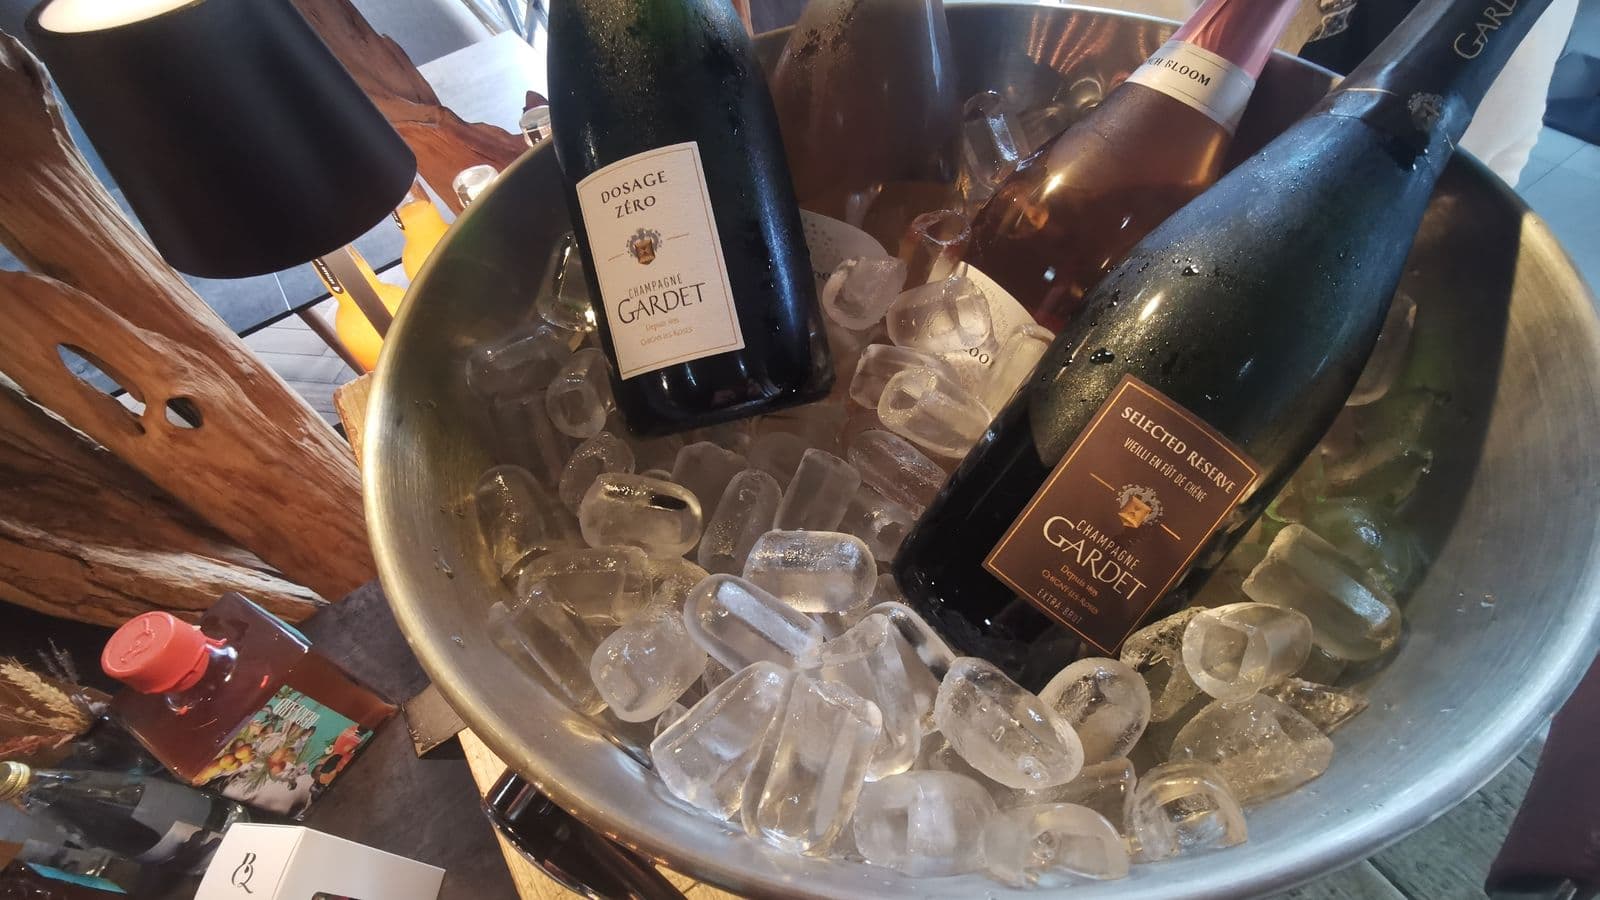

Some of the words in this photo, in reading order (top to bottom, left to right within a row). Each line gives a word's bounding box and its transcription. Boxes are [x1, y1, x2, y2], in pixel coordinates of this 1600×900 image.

[1165, 59, 1211, 86] BLOOM
[601, 170, 668, 204] DOSAGE
[615, 195, 656, 218] ZÉRO
[618, 282, 705, 324] GARDET
[628, 273, 682, 299] CHAMPAGNE
[1121, 406, 1187, 455] SELECTED
[1186, 450, 1236, 494] RESERVE
[1123, 437, 1151, 461] VIEILLI
[1148, 455, 1163, 469] EN
[1173, 473, 1187, 487] DE
[1043, 515, 1147, 600] GARDET
[1076, 519, 1140, 571] CHAMPAGNE
